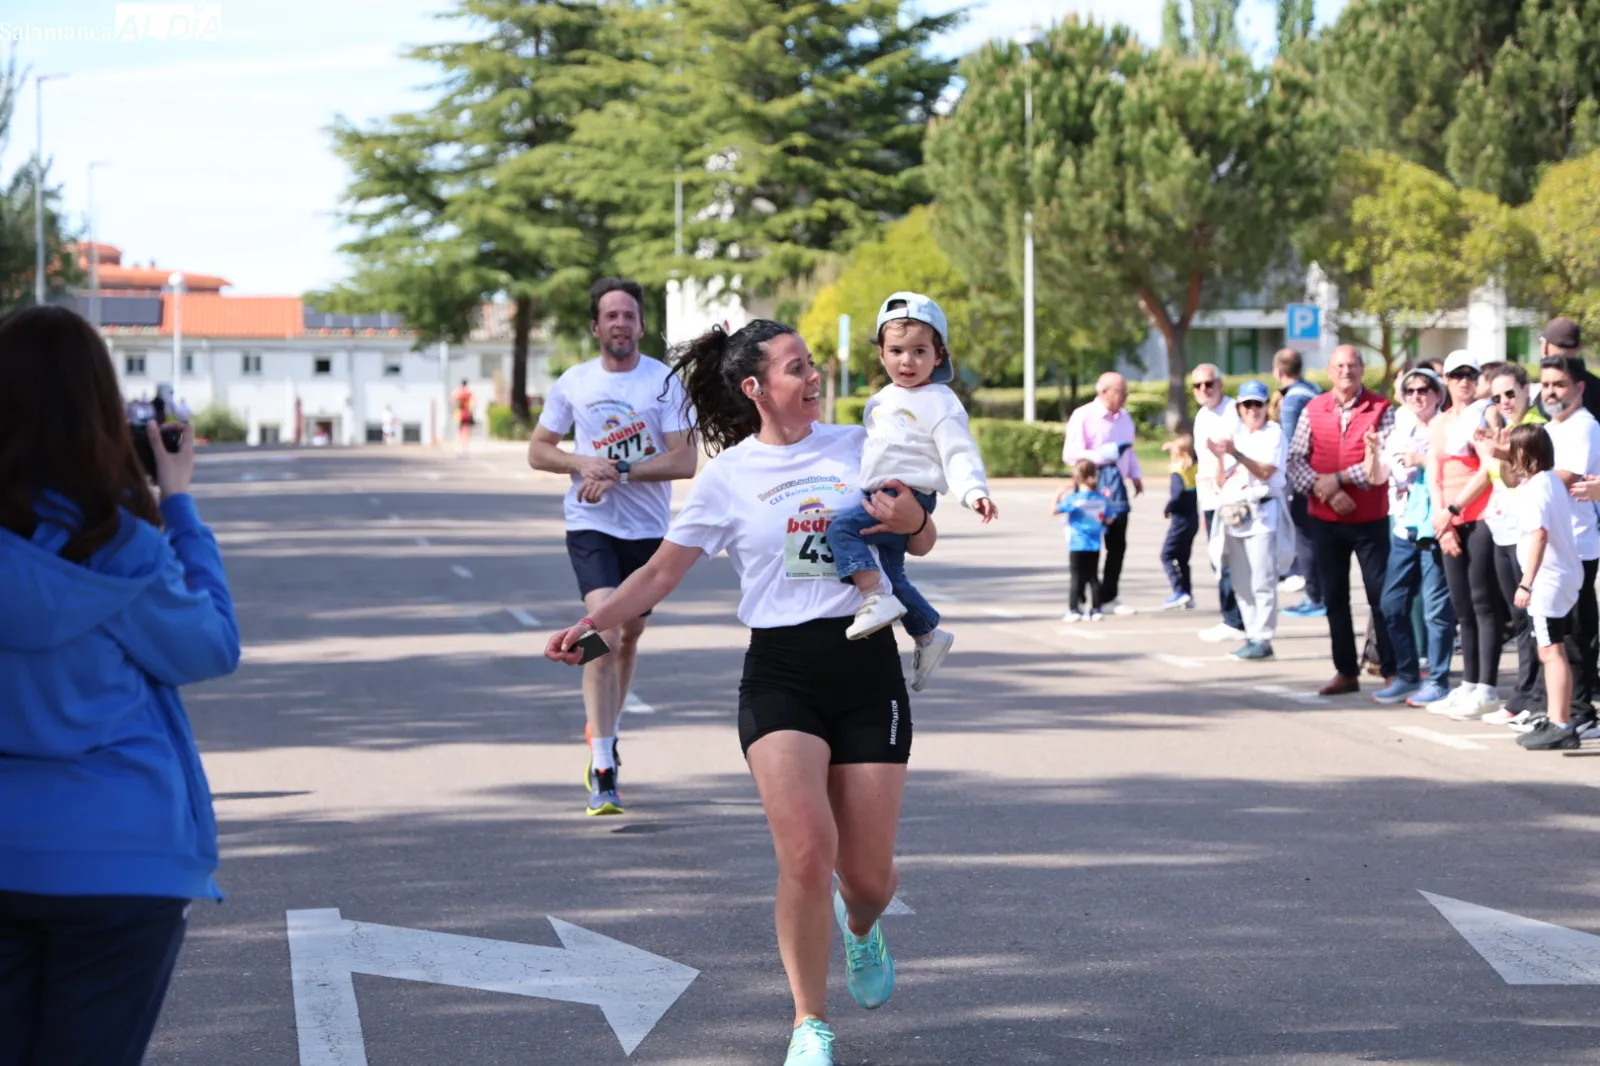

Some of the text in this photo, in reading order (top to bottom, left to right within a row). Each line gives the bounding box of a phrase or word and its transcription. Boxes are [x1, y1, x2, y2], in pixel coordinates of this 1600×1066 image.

[1293, 308, 1315, 335] P
[769, 494, 784, 505] CEE
[785, 487, 809, 498] Reina
